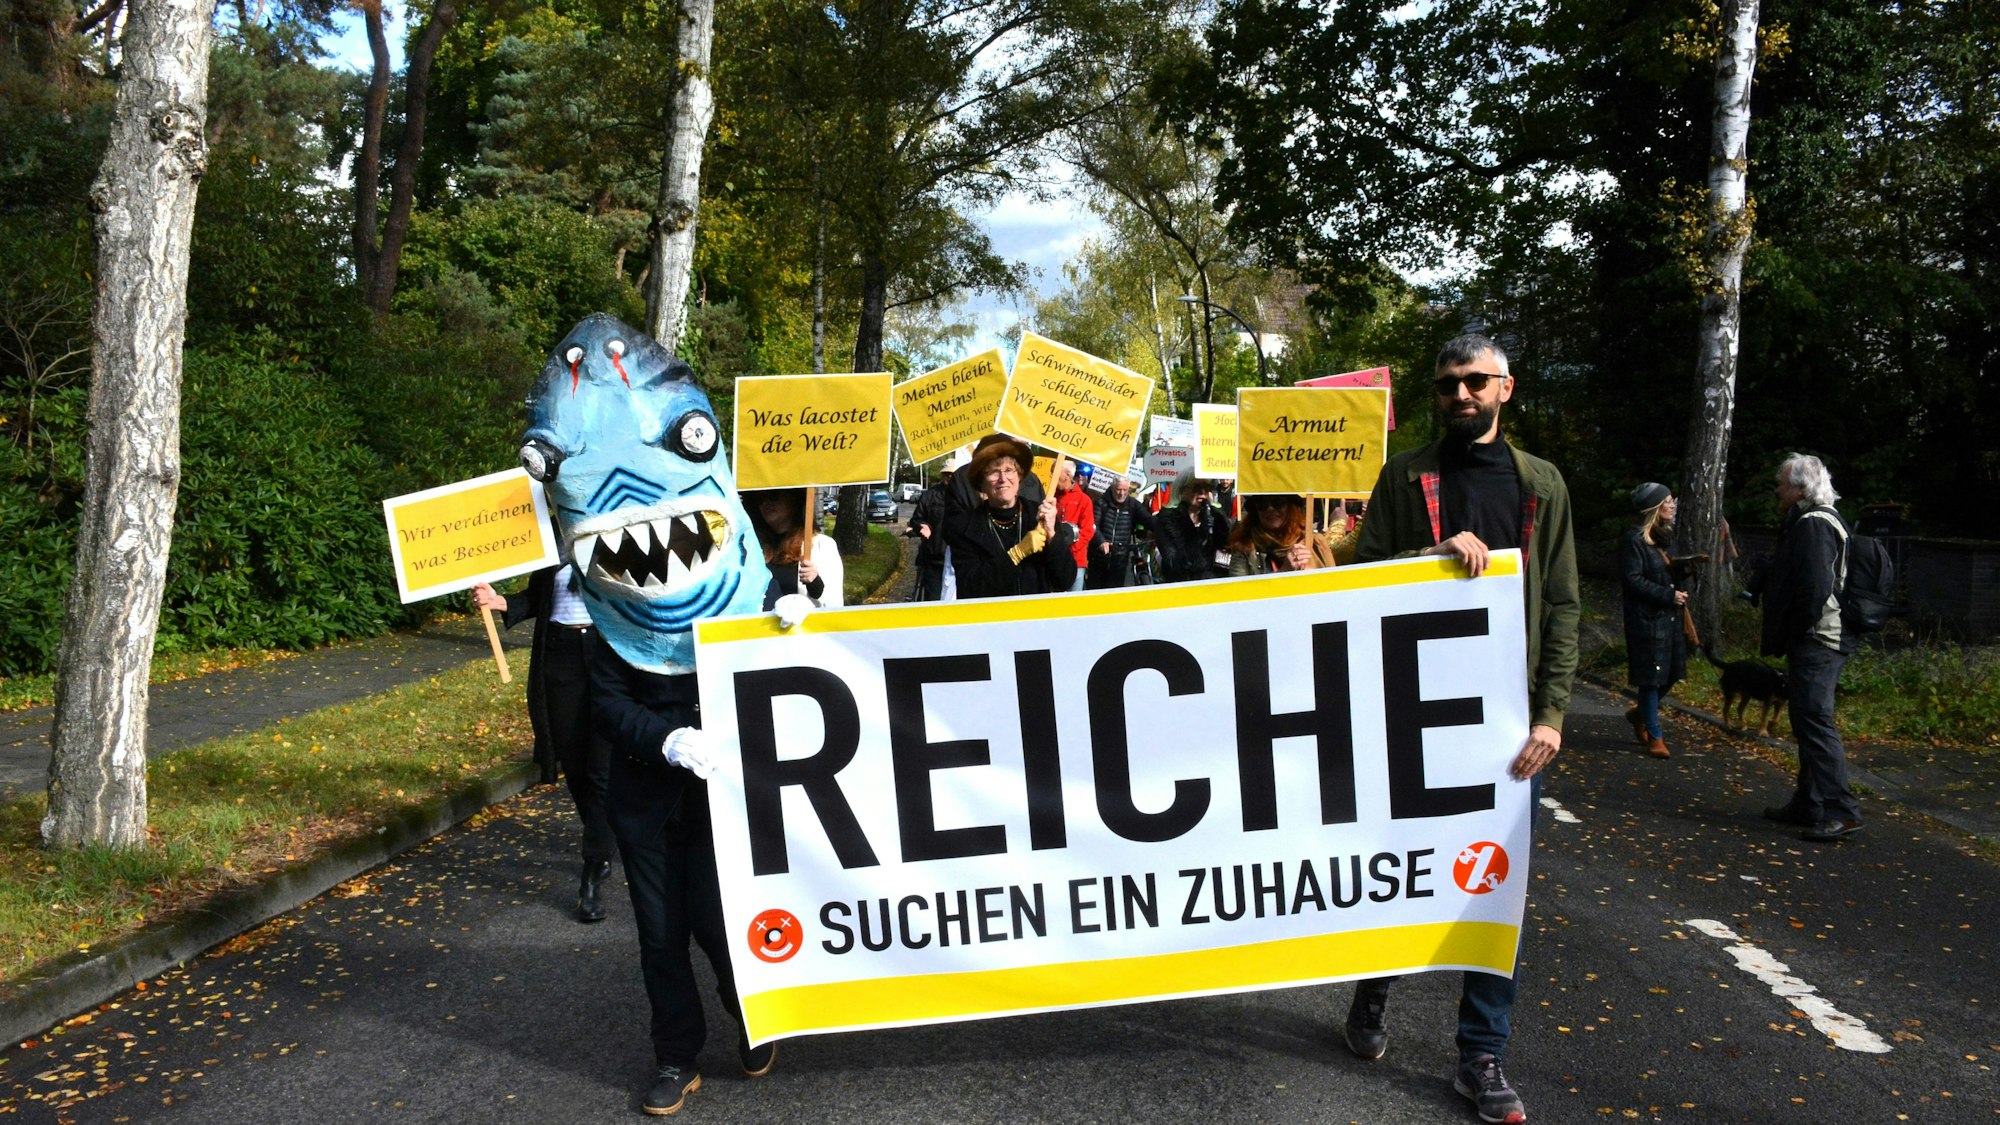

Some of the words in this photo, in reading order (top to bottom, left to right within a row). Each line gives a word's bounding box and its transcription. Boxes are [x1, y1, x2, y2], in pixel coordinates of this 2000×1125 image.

[902, 380, 947, 406] Meins
[952, 360, 993, 387] bleibt
[1027, 350, 1139, 399] Schwimmbäder
[928, 388, 977, 417] Meins!
[1041, 378, 1112, 410] schließen!
[747, 409, 793, 428] Was
[800, 406, 878, 425] lacostet
[910, 413, 970, 440] Reichtum,
[973, 402, 992, 416] wie
[1012, 386, 1043, 409] Wir
[1045, 401, 1092, 429] haben
[1095, 422, 1132, 443] doch
[1214, 414, 1237, 425] Hoc
[1269, 416, 1348, 433] Armut
[761, 435, 792, 453] die
[799, 432, 858, 451] Welt?
[920, 436, 948, 454] singt
[951, 423, 975, 441] und
[977, 414, 997, 431] lac
[1041, 423, 1087, 449] Pools!
[1252, 442, 1364, 462] besteuern!
[398, 525, 436, 544] Wir
[441, 502, 535, 534] verdienen
[411, 554, 447, 572] was
[453, 529, 533, 562] Besseres!
[732, 607, 1497, 878] REICHE
[820, 881, 1048, 955] SUCHEN
[1070, 872, 1161, 934] EIN
[1178, 848, 1437, 925] ZUHAUSE
